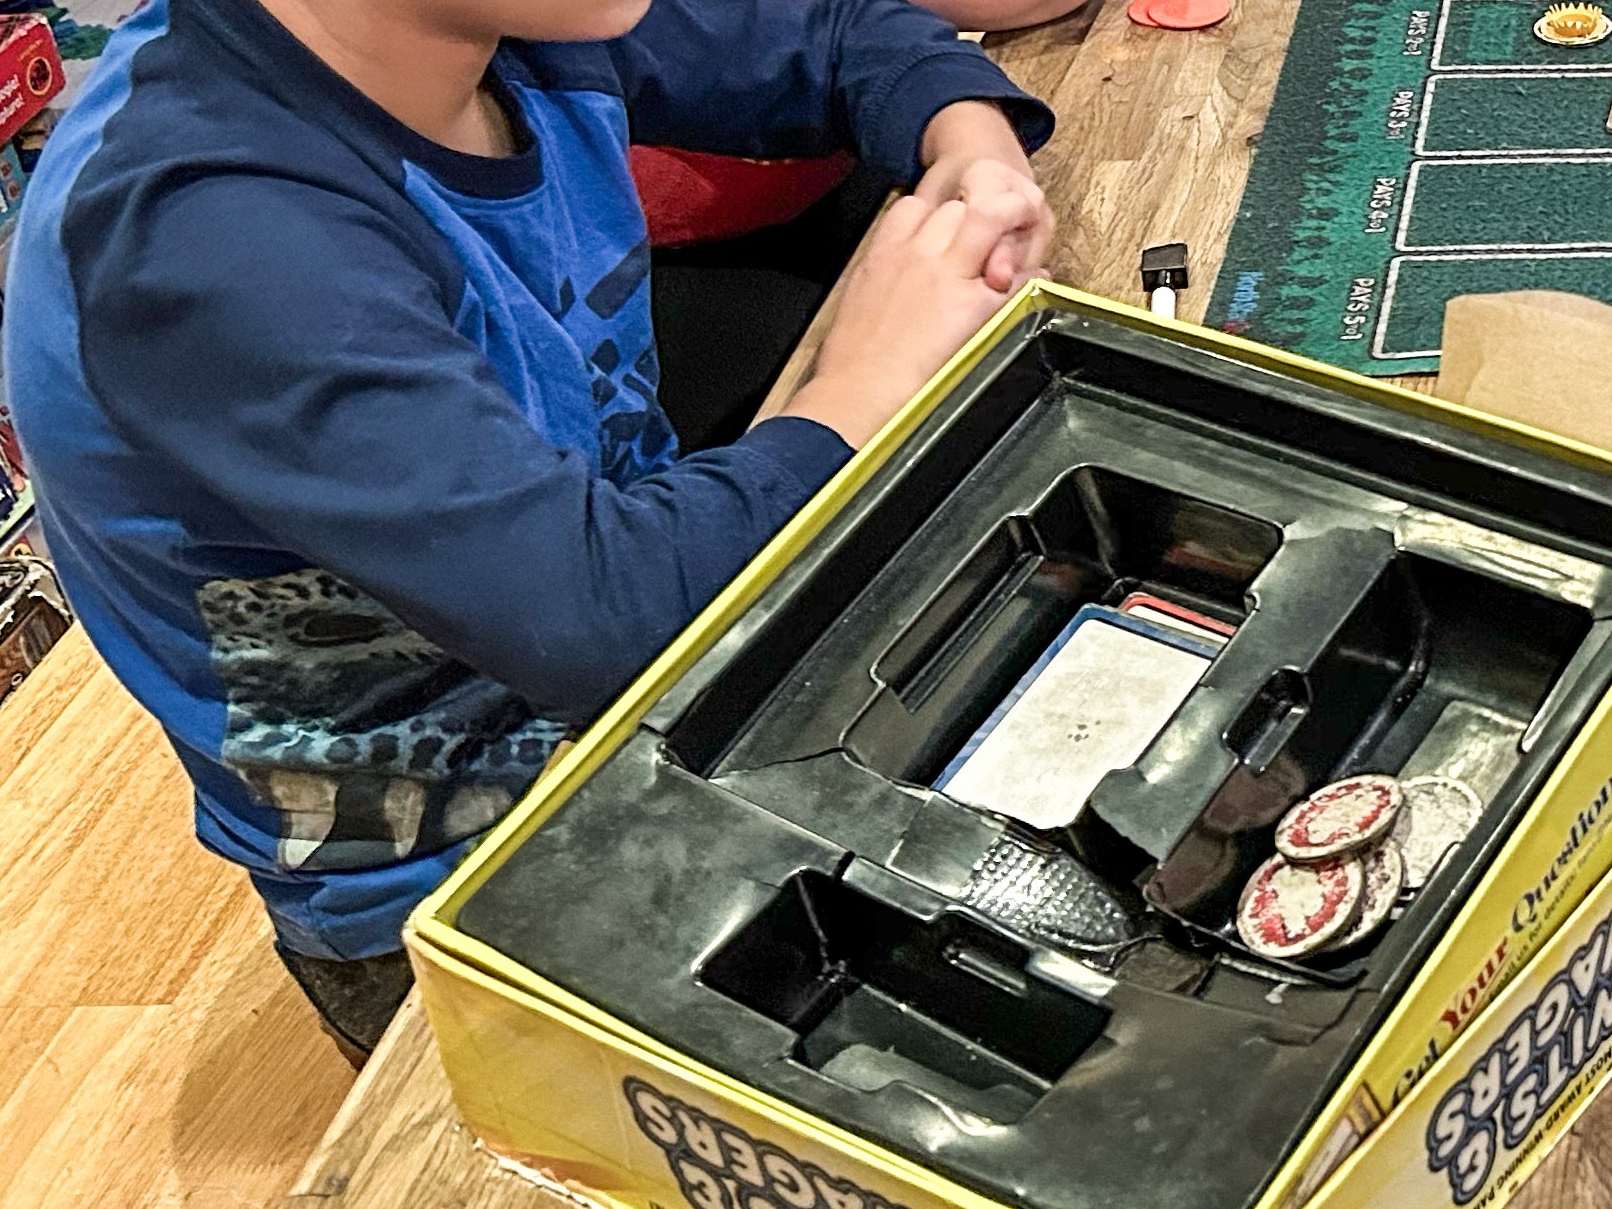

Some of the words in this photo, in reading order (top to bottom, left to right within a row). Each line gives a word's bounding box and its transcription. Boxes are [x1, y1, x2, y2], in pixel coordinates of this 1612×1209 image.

[1406, 11, 1430, 35] PAYS
[1389, 91, 1414, 117] PAYS
[1369, 178, 1396, 208] PAYS
[1347, 278, 1375, 311] PAYS
[1439, 935, 1509, 1031] Your
[1583, 1049, 1612, 1082] MOST
[630, 1082, 915, 1209] AGERS
[1496, 1080, 1584, 1195] AWARD-WINNING
[1453, 1122, 1493, 1200] &
